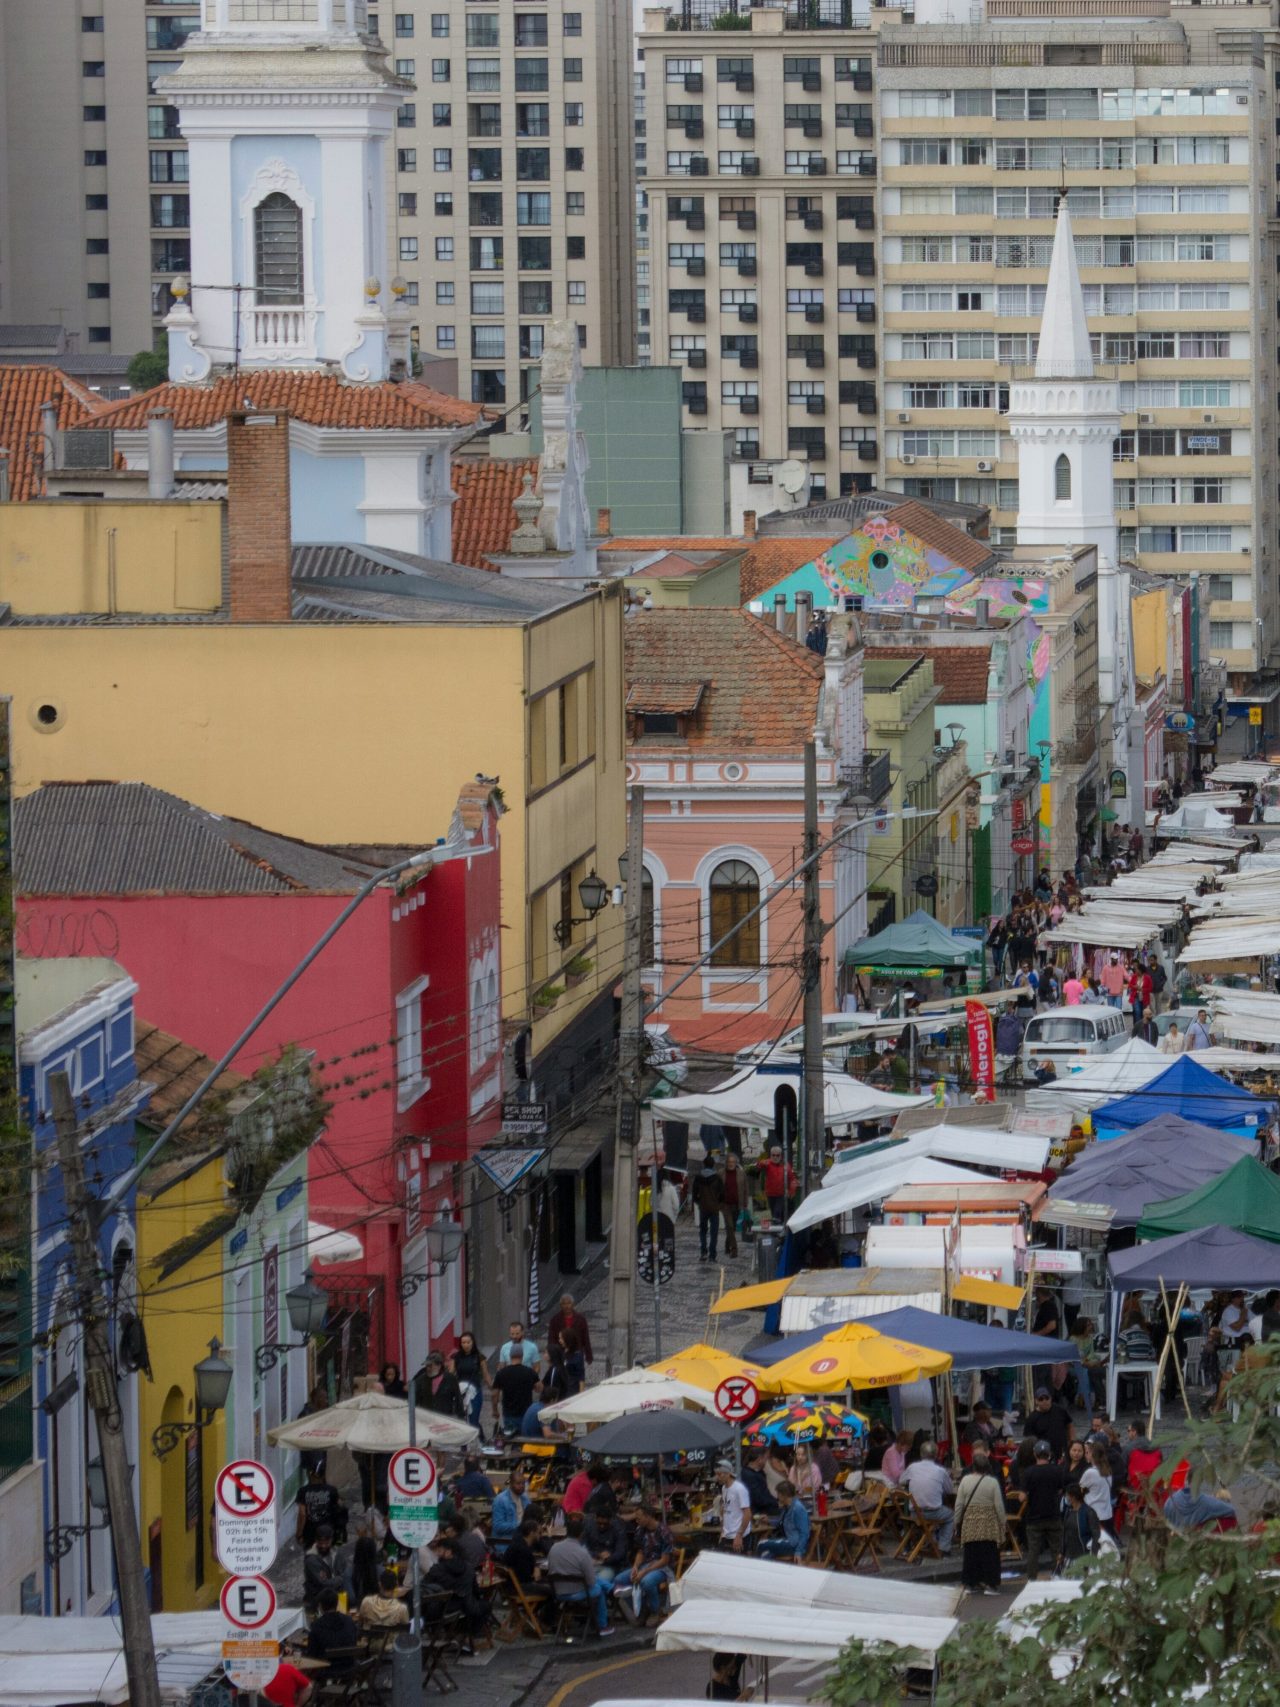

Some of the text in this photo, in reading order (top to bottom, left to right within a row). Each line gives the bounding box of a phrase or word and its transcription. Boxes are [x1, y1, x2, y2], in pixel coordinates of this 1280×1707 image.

[974, 1023, 989, 1091] Pierogi
[522, 1106, 543, 1115] SHOP
[687, 1449, 706, 1461] elo
[404, 1458, 420, 1485] E
[235, 1472, 255, 1505] E
[219, 1519, 258, 1527] Domingos
[226, 1545, 269, 1553] Artesanato
[234, 1564, 262, 1572] quadra
[238, 1585, 258, 1616] E
